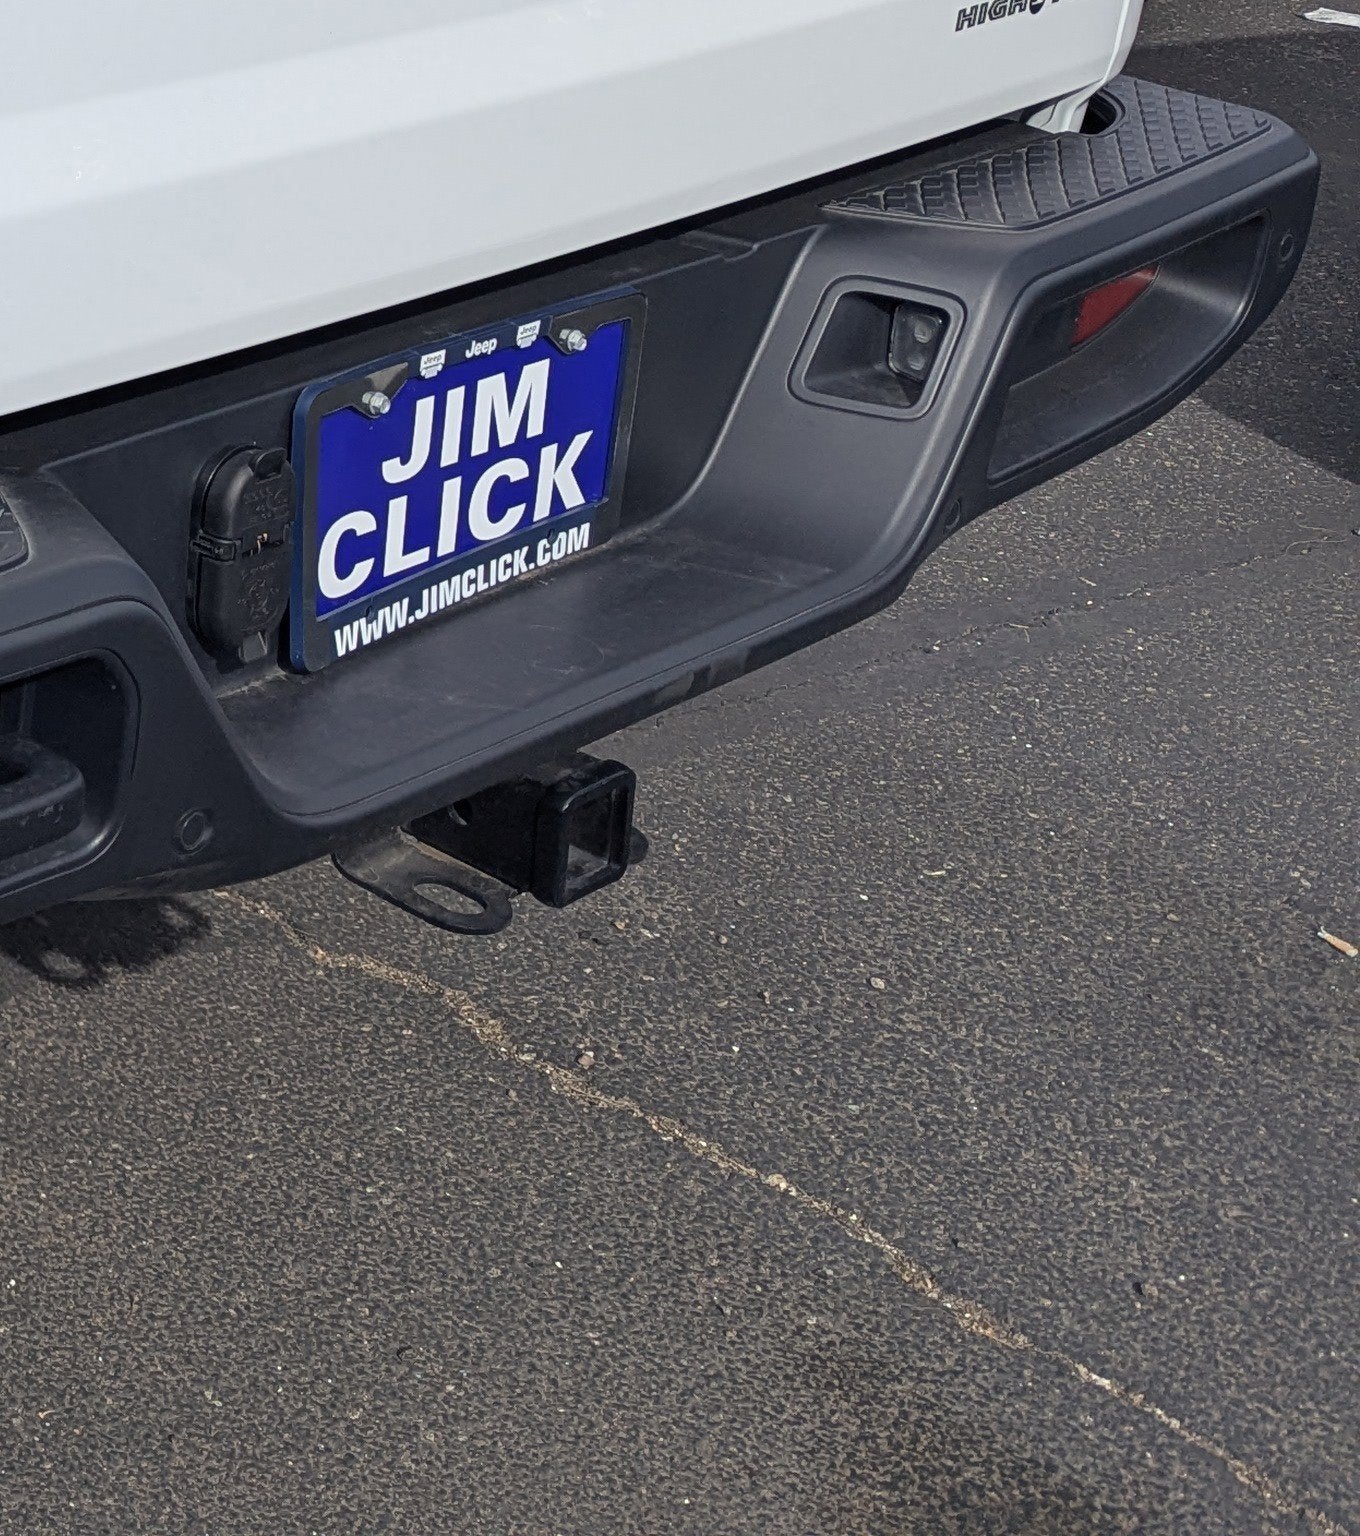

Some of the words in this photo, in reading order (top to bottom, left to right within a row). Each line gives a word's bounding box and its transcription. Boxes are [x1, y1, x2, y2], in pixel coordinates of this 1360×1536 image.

[465, 337, 498, 359] Jeep
[381, 357, 551, 485] JIM
[317, 430, 594, 600] CLICK
[334, 521, 591, 659] WWW.JIMCLICK.COM
